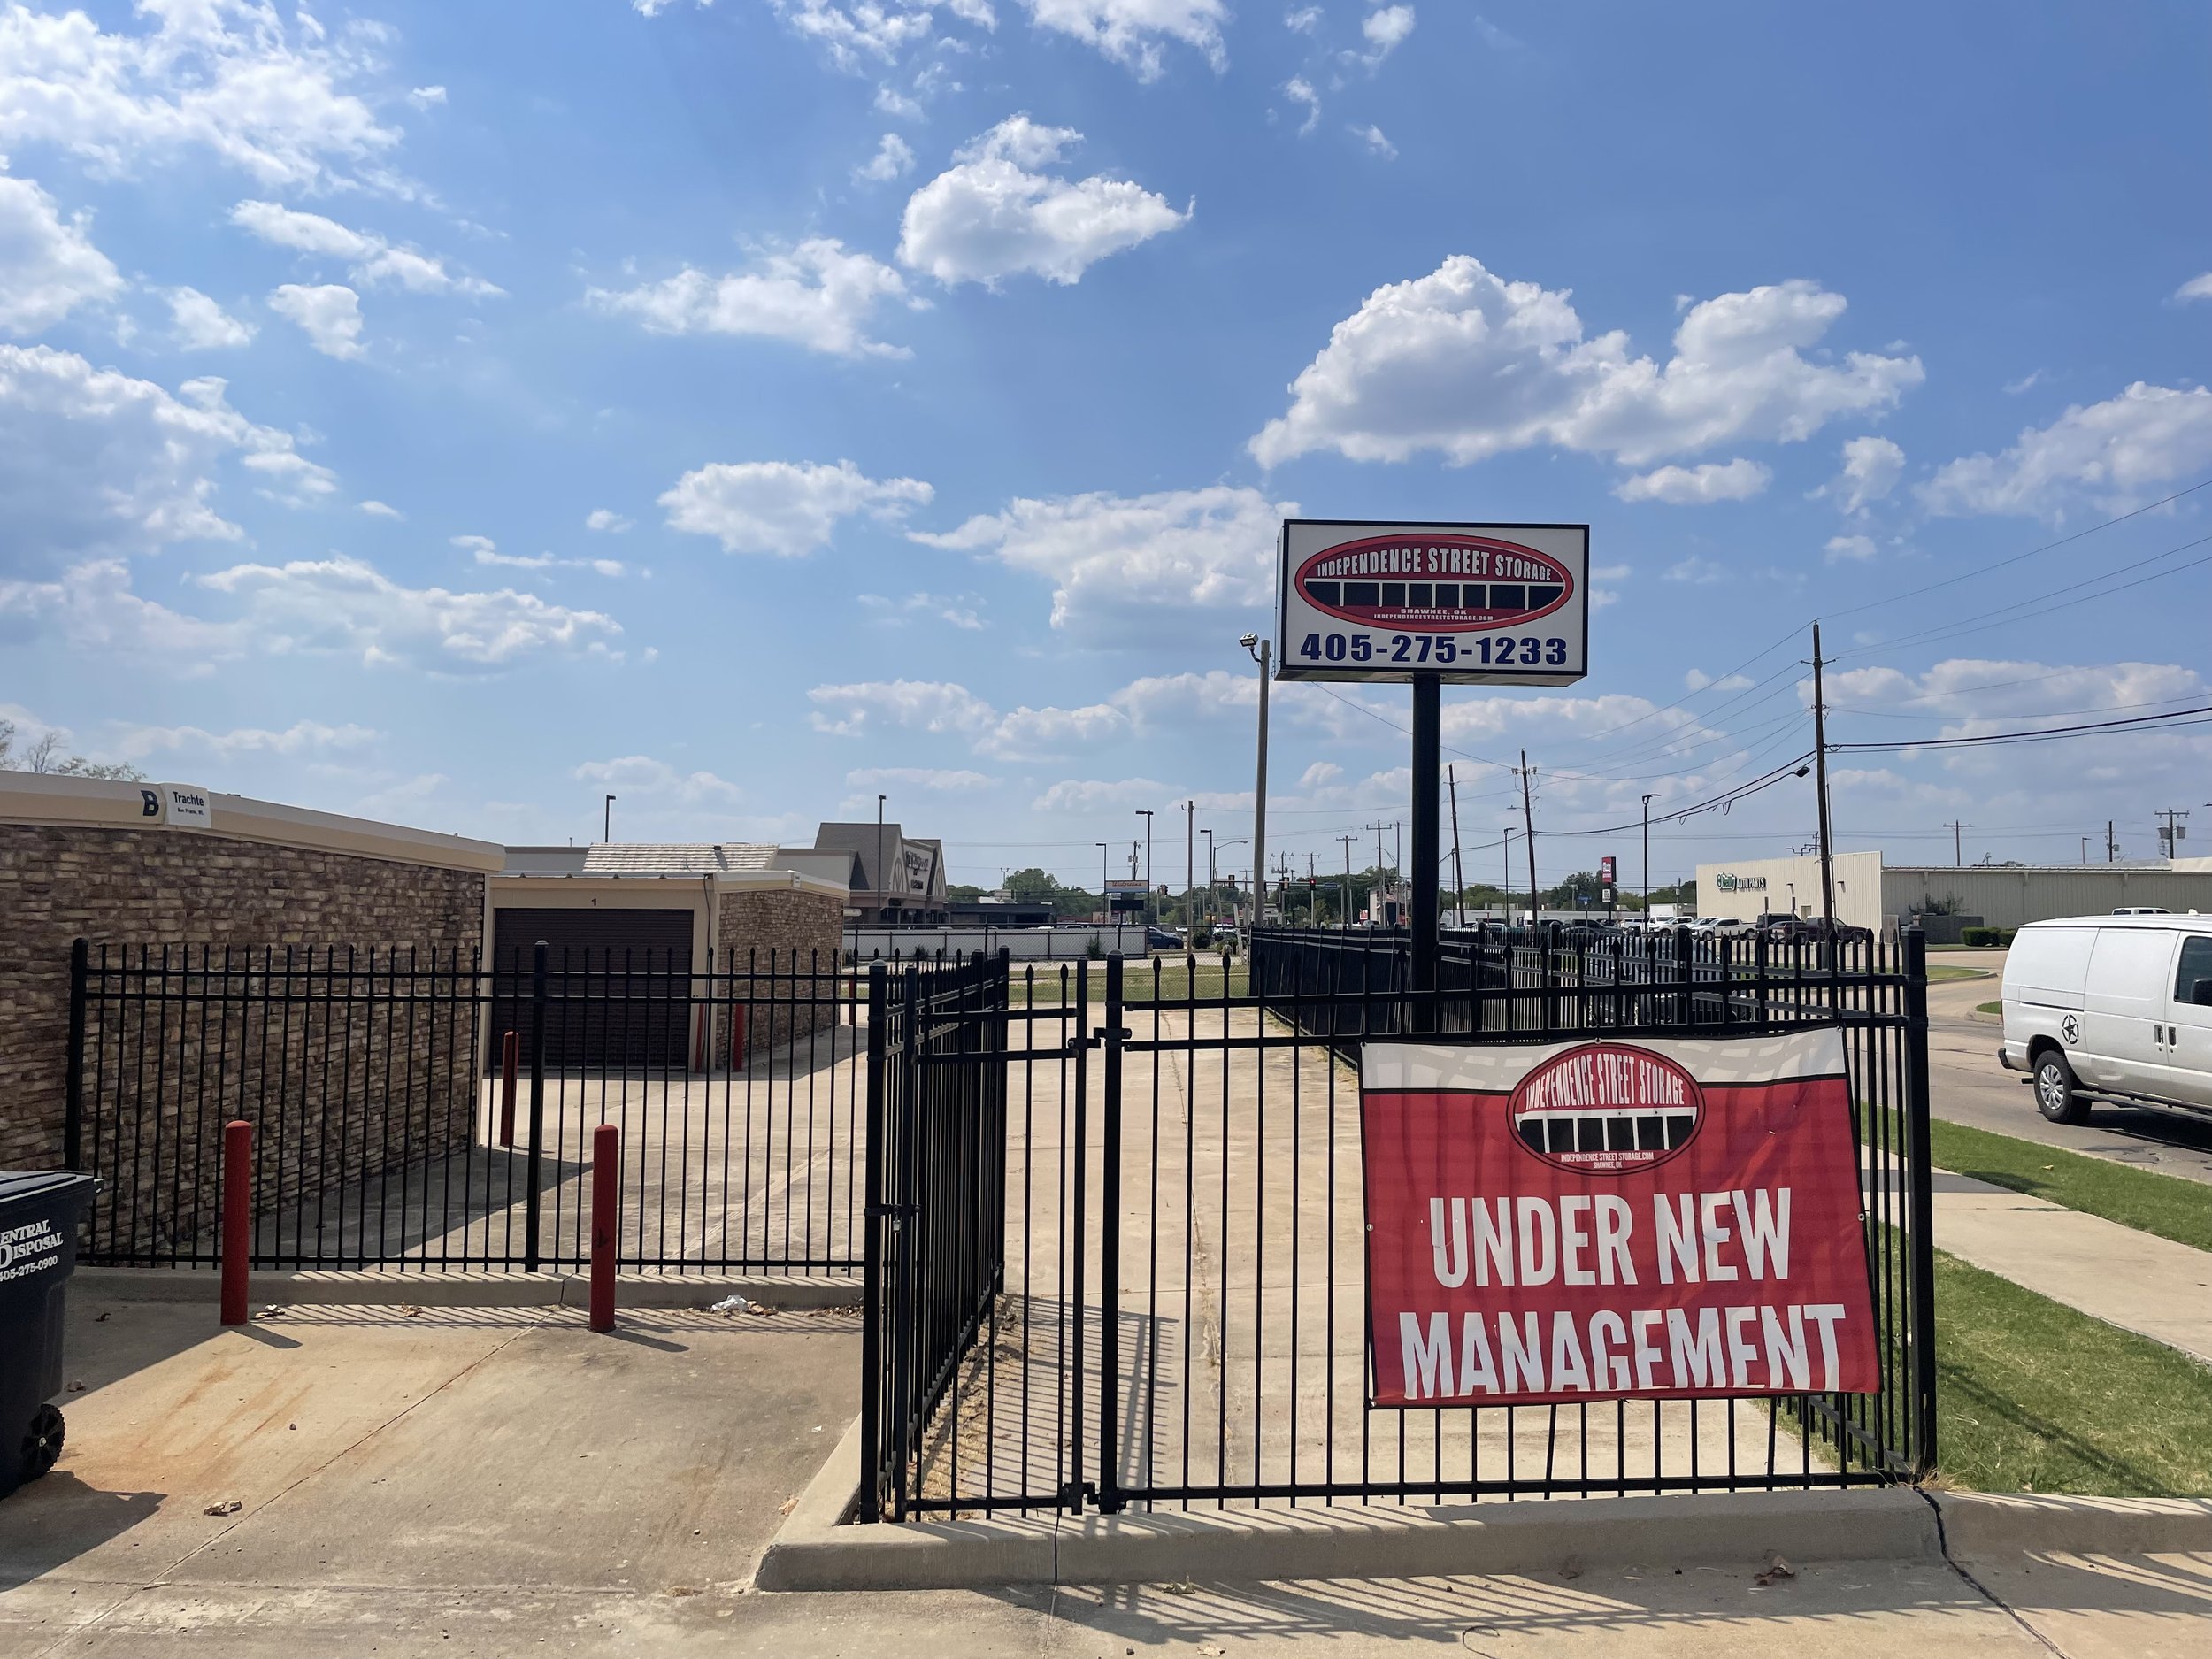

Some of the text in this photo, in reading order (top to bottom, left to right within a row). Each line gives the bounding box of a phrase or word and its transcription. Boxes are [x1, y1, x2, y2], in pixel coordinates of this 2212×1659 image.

[1317, 547, 1552, 581] INDEPENDENCE STREET STORAGE
[1300, 633, 1568, 665] 405-275-1233
[141, 790, 159, 816] B
[173, 791, 204, 806] Trachte
[591, 897, 597, 907] 1
[1526, 1053, 1685, 1110] INDEPENDENCE STREET STORAGE
[1561, 1151, 1654, 1162] INDEPENDENCE STREET STORAGE.COM
[0, 1219, 50, 1246] ENTRAL
[1429, 1187, 1791, 1289] UNDER NEW
[1398, 1303, 1846, 1401] MANAGEMENT
